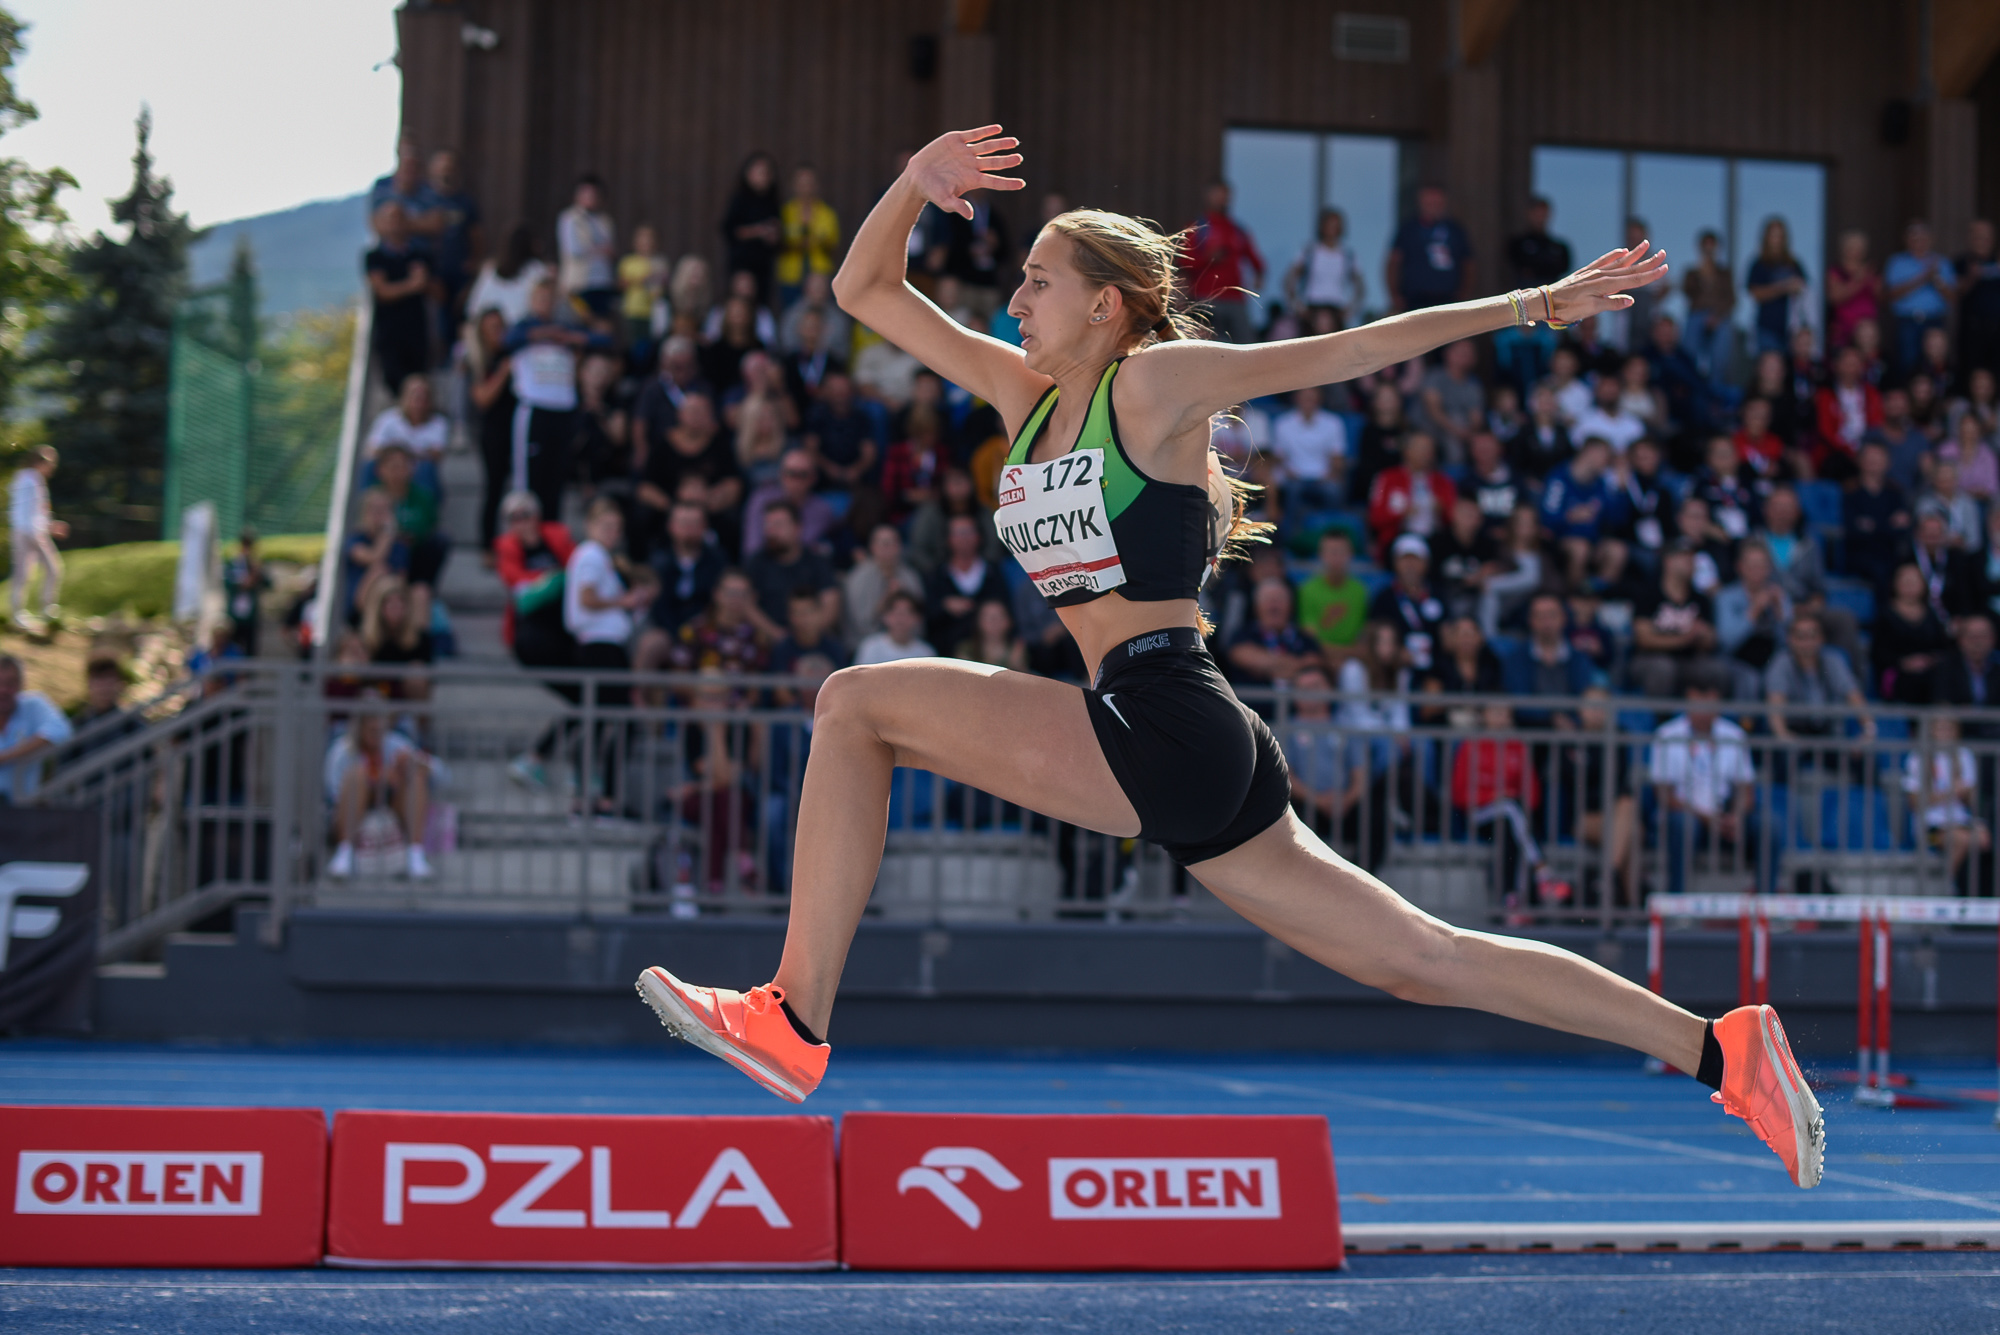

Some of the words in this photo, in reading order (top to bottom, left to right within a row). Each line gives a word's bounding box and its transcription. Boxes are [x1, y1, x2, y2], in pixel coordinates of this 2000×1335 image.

[1042, 455, 1093, 493] 172
[1001, 506, 1103, 555] KULCZYK
[1128, 633, 1171, 657] NIKE
[31, 1161, 244, 1204] ORLEN
[383, 1142, 793, 1228] PZLA
[1063, 1168, 1265, 1210] ORLEN
